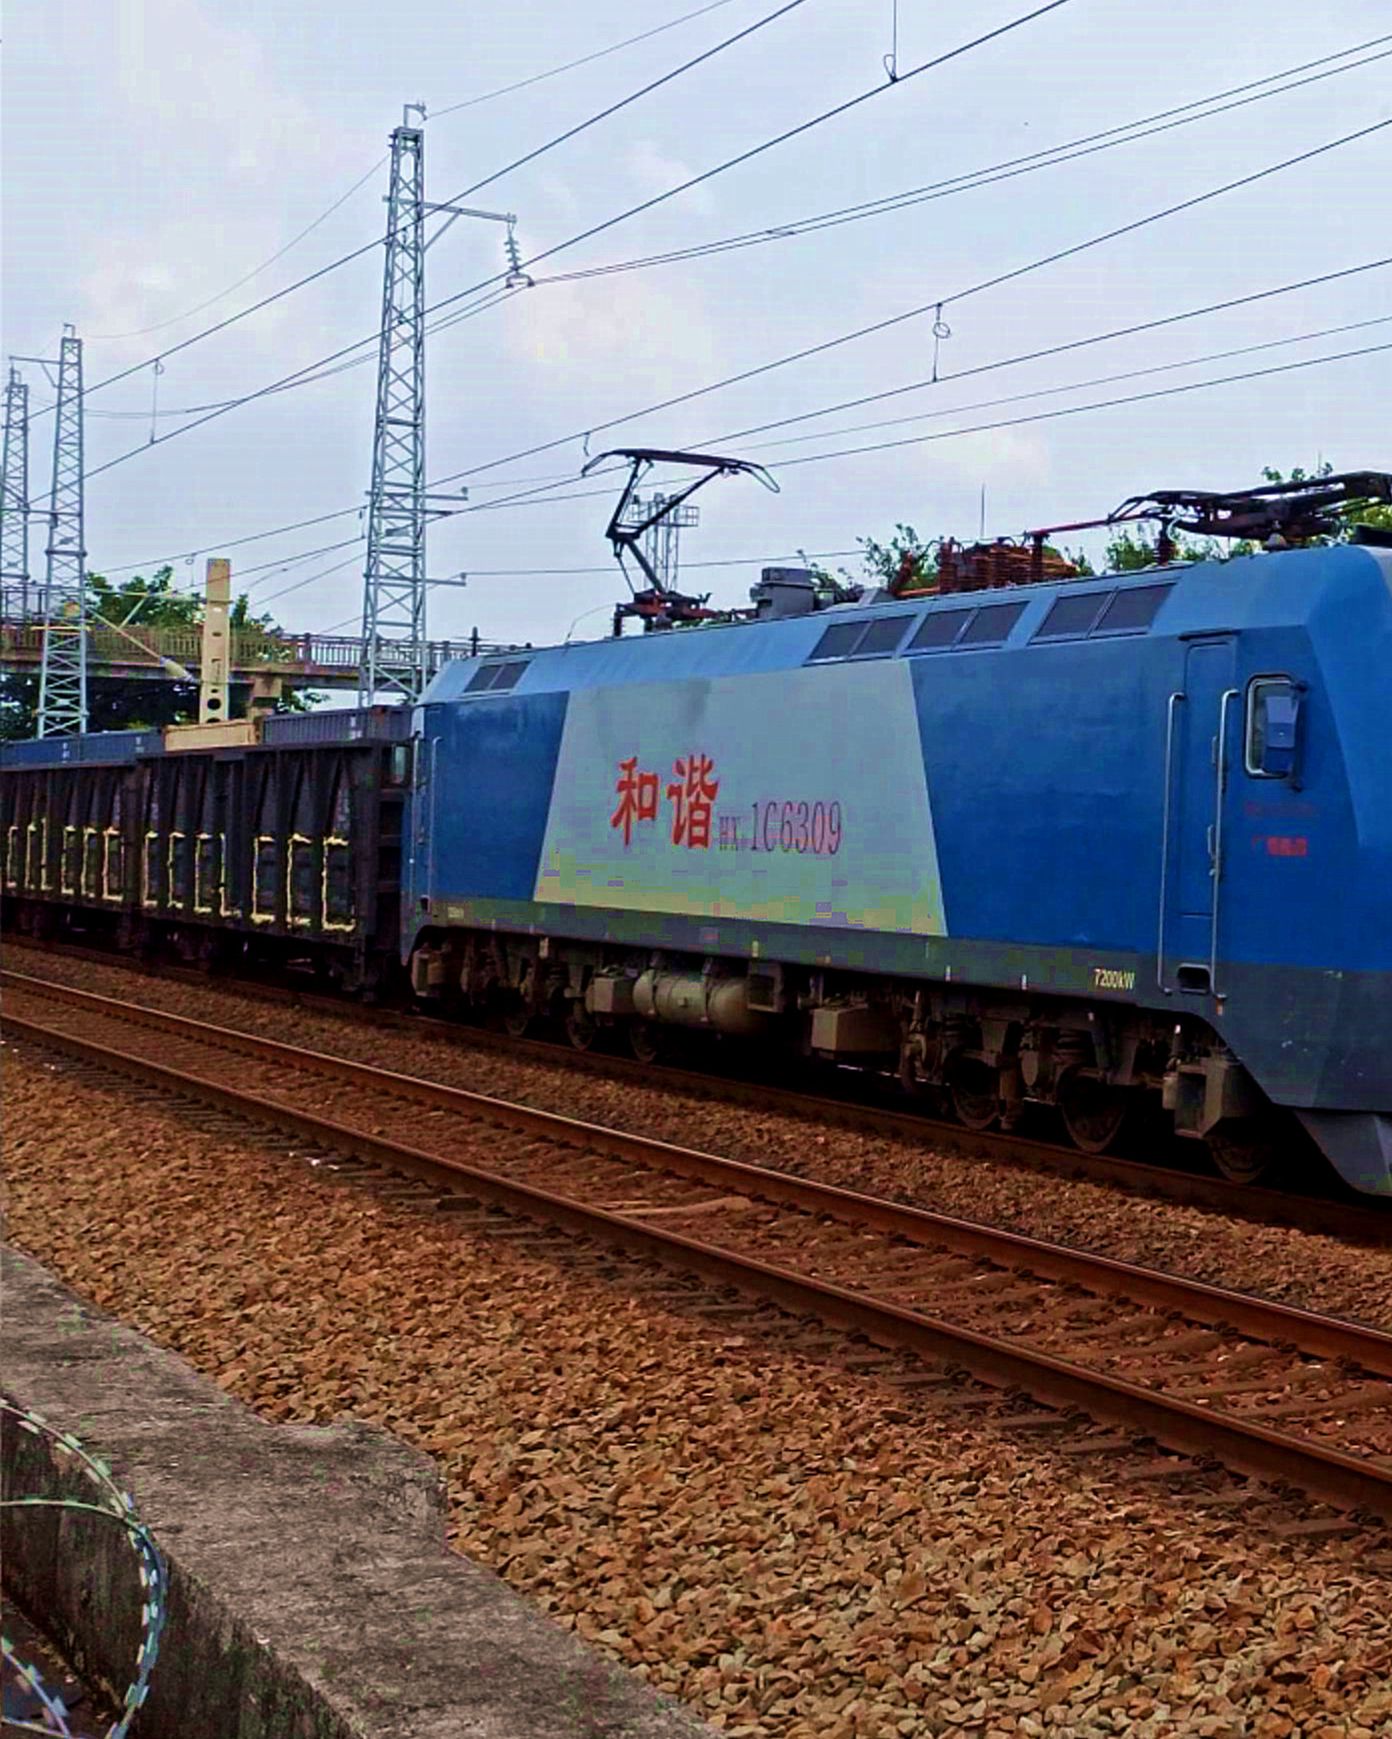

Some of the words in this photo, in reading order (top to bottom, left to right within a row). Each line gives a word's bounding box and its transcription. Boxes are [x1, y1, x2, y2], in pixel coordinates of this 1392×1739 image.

[611, 753, 719, 849] 和谐
[719, 800, 842, 855] HX1C6309
[1093, 967, 1136, 990] 7200kW
